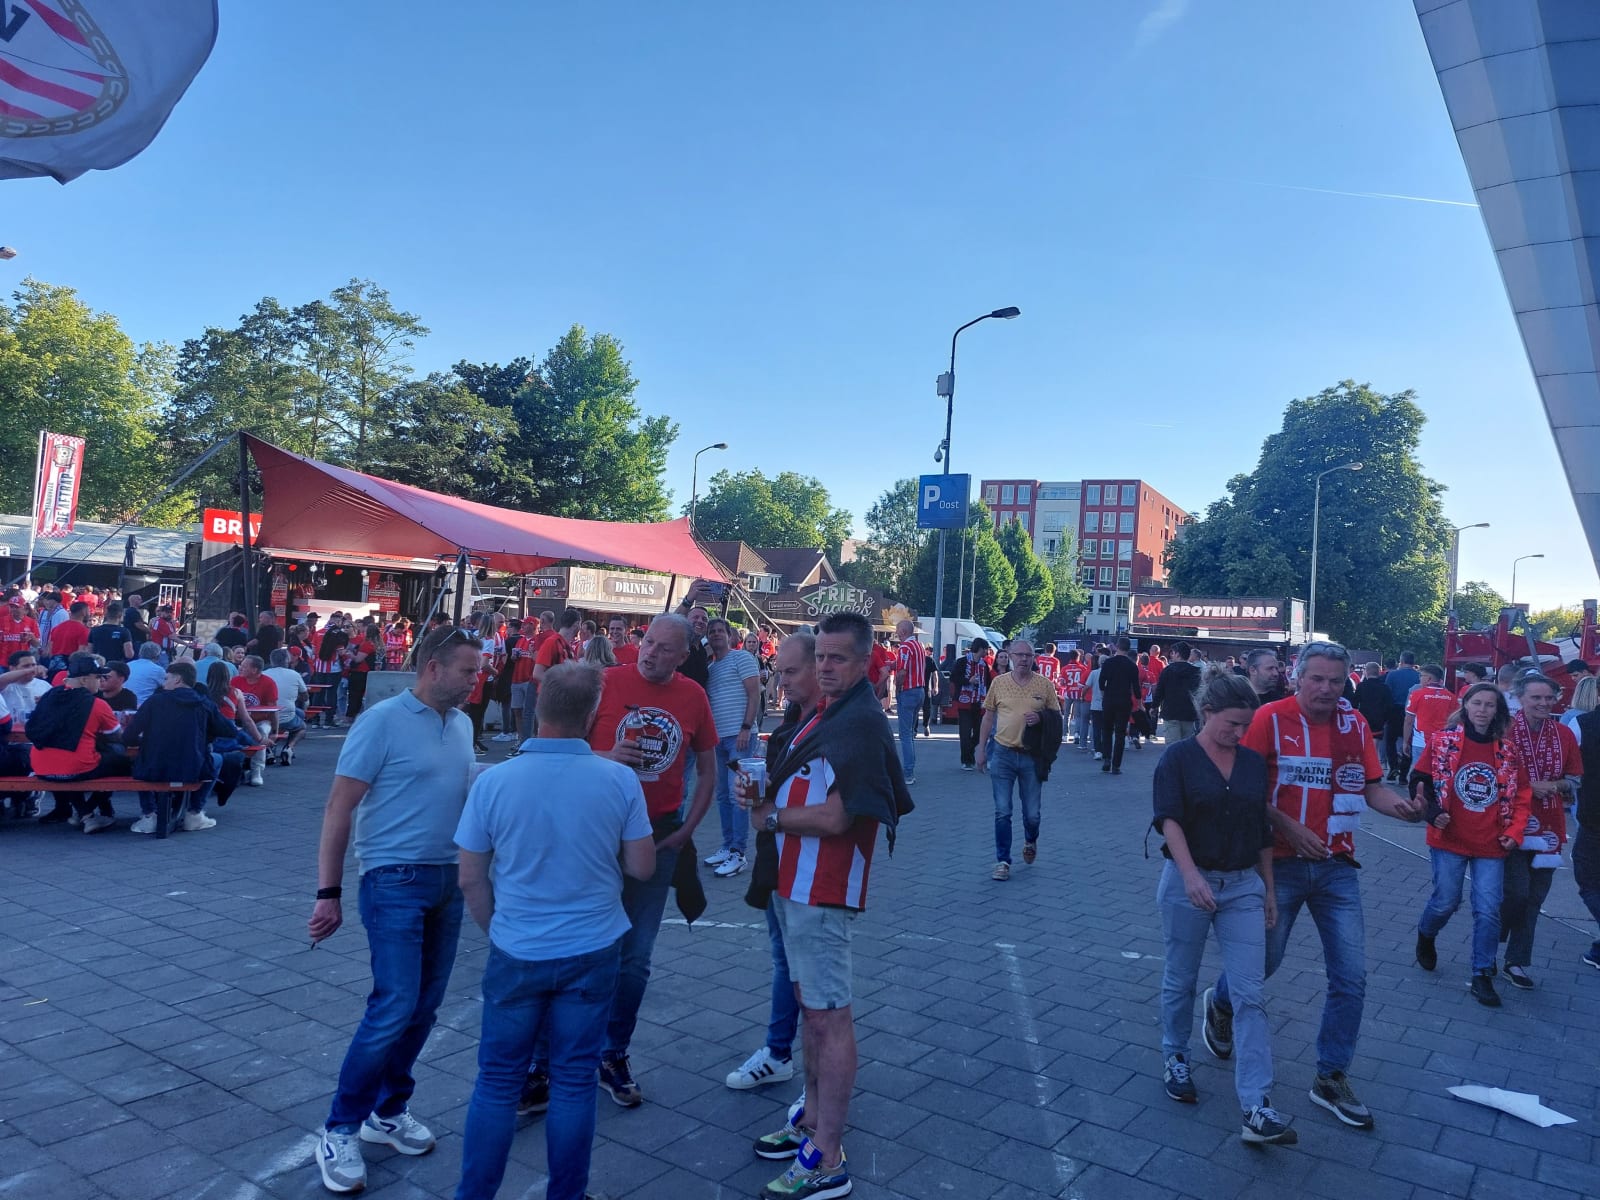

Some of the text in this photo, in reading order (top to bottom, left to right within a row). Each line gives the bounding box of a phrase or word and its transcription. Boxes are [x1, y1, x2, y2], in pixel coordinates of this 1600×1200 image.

[57, 473, 74, 509] AFTRAP
[923, 485, 960, 510] P Oost
[615, 581, 655, 595] DRINKS
[818, 585, 867, 603] FRIET
[1137, 601, 1278, 618] XXL PROTEIN BAR
[1067, 671, 1081, 686] 34
